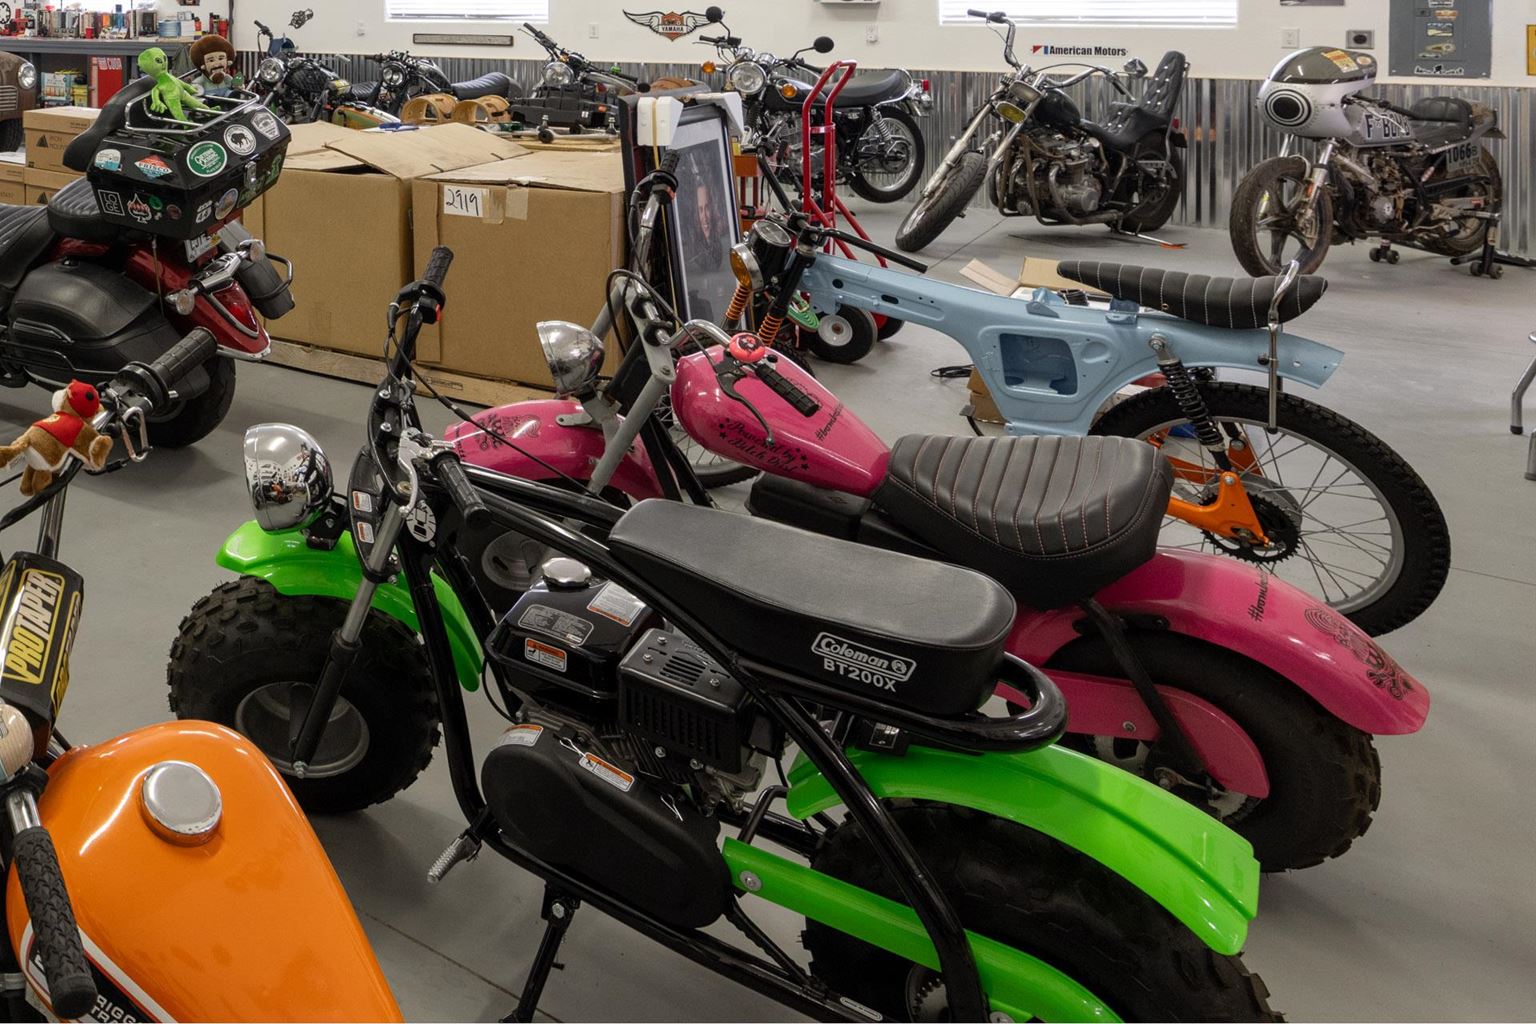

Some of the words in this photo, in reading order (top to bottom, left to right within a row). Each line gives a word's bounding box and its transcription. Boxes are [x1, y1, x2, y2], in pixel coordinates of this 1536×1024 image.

[1050, 45, 1092, 55] American
[1094, 46, 1126, 56] Motors
[138, 162, 169, 172] FRISCO
[446, 188, 479, 216] 2919
[820, 637, 890, 669] Coleman
[823, 657, 897, 692] BT200X
[90, 1005, 119, 1023] TRA
[96, 994, 144, 1023] RIGG
